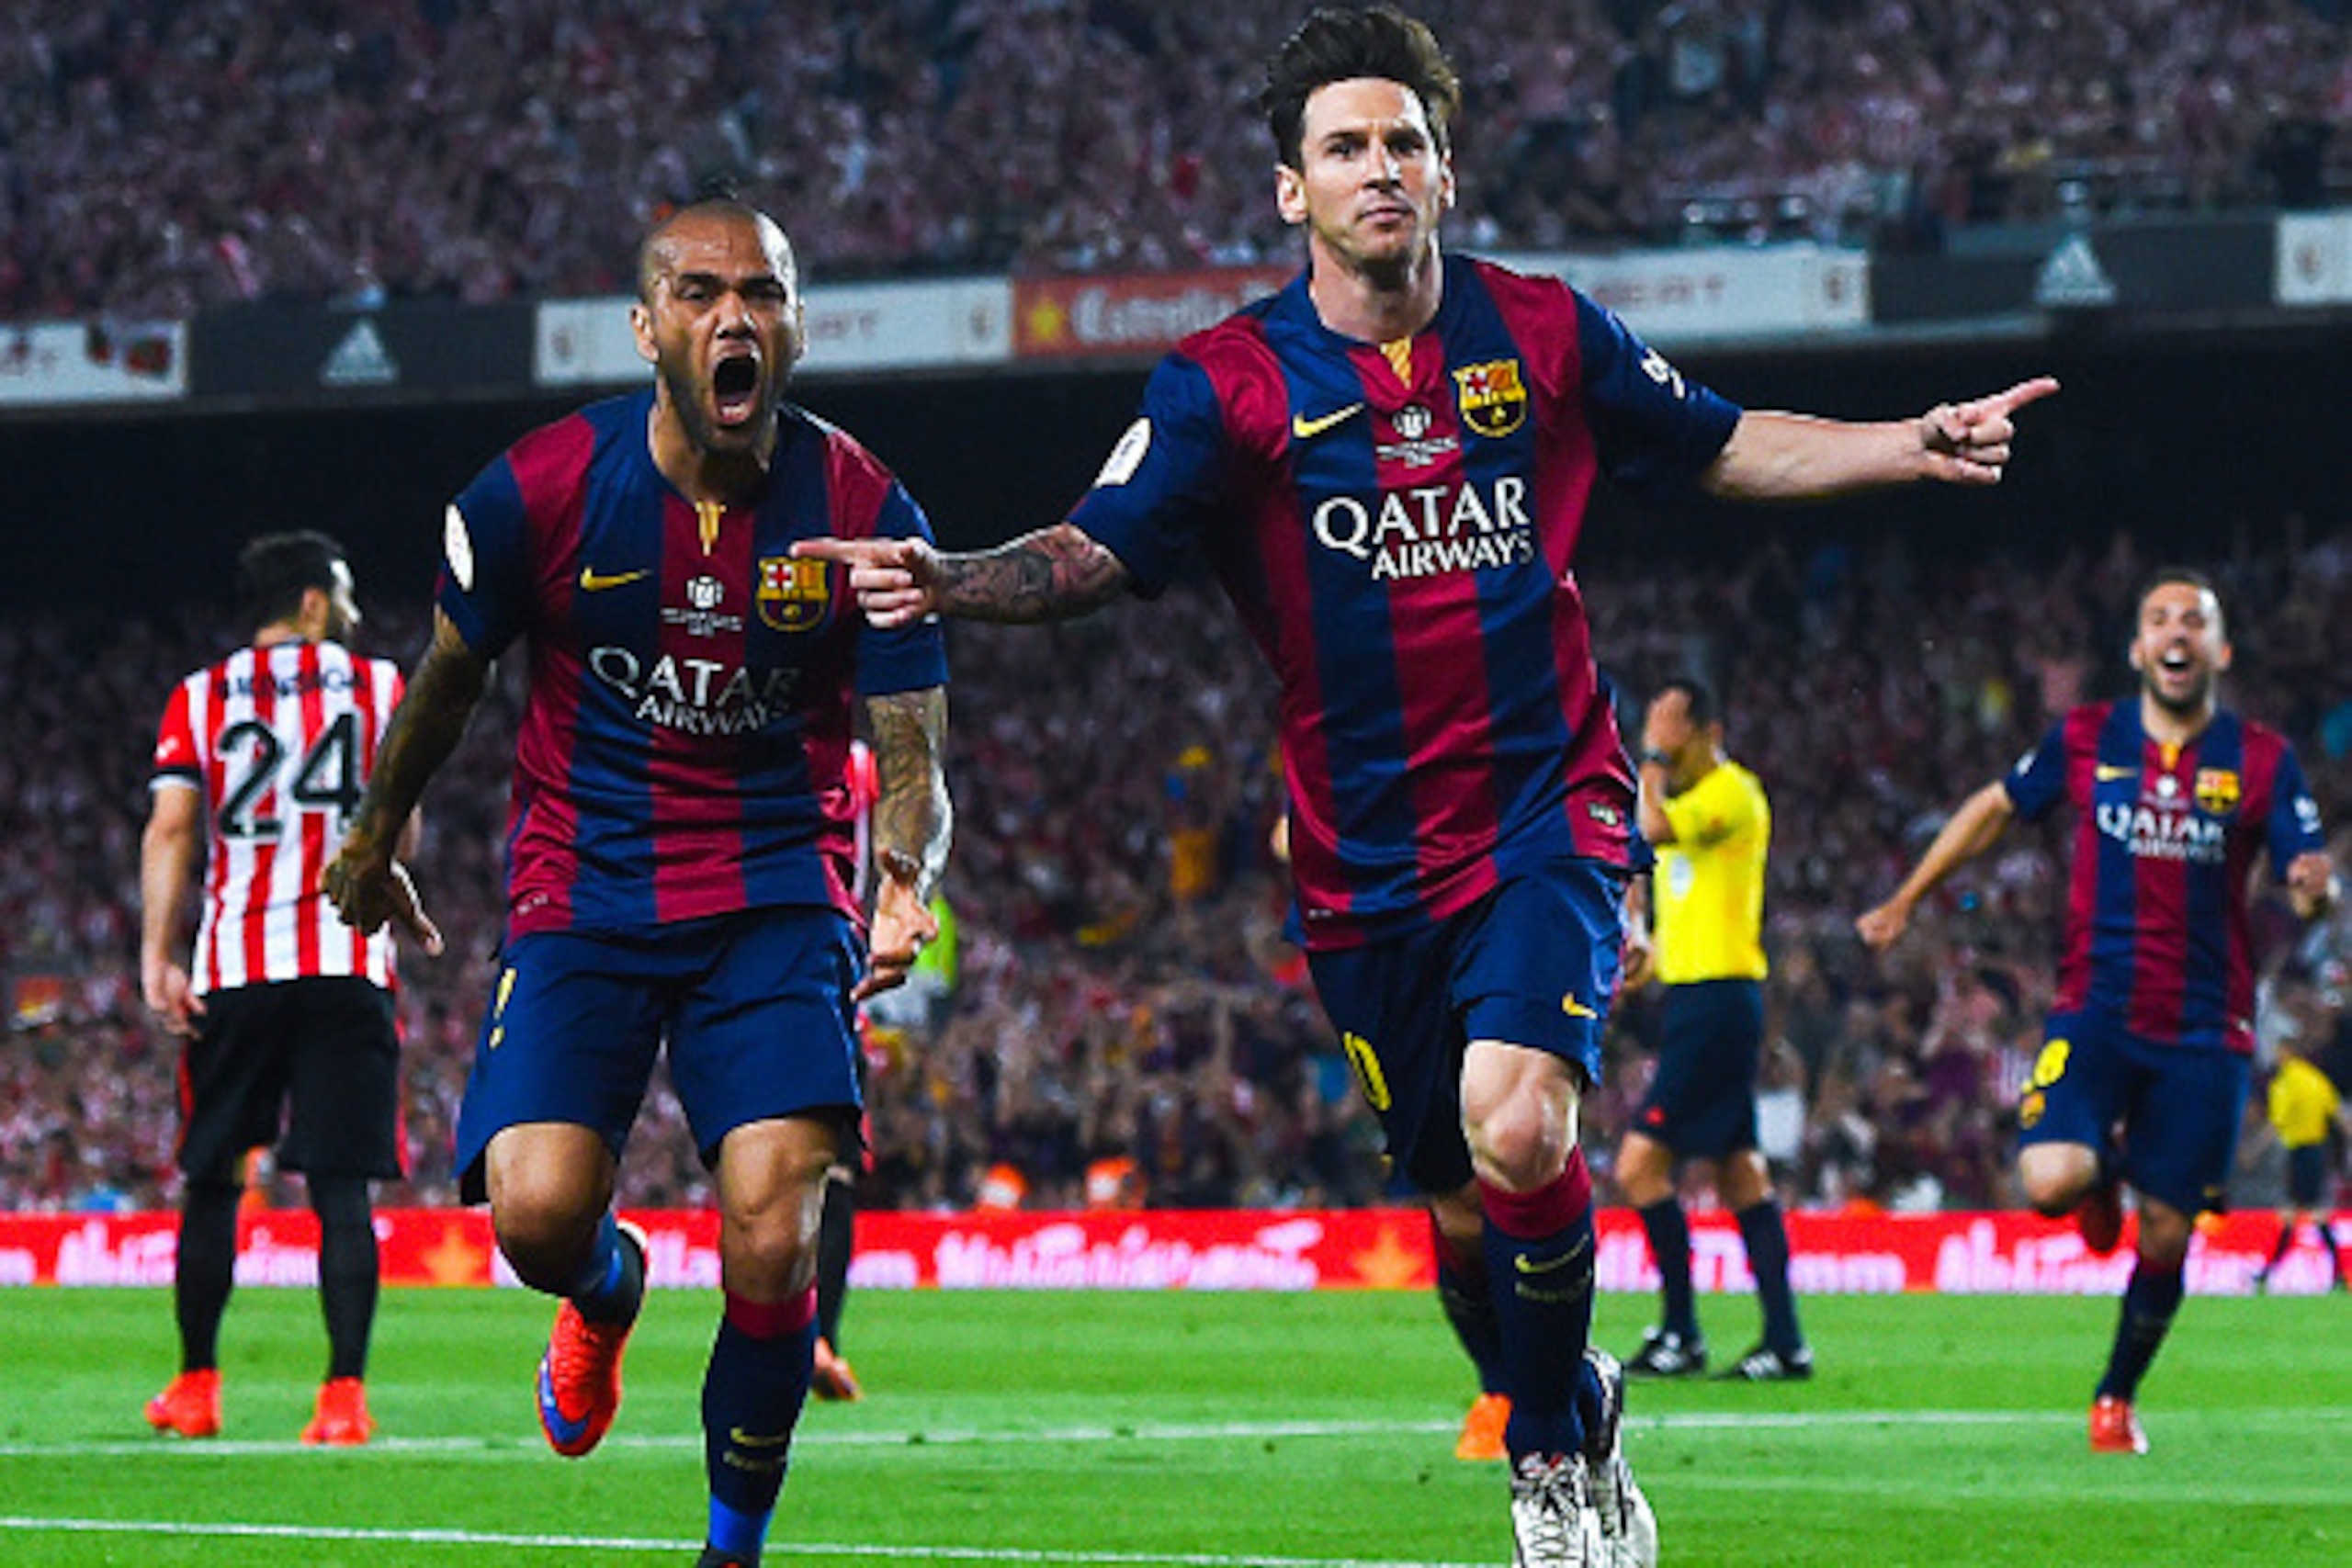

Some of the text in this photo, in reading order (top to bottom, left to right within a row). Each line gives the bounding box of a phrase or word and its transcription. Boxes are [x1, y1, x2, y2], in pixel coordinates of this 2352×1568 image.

[1312, 476, 1531, 560] QATAR
[1371, 528, 1534, 581] AIRWAYS
[588, 645, 798, 707] QATAR
[217, 712, 361, 835] 24
